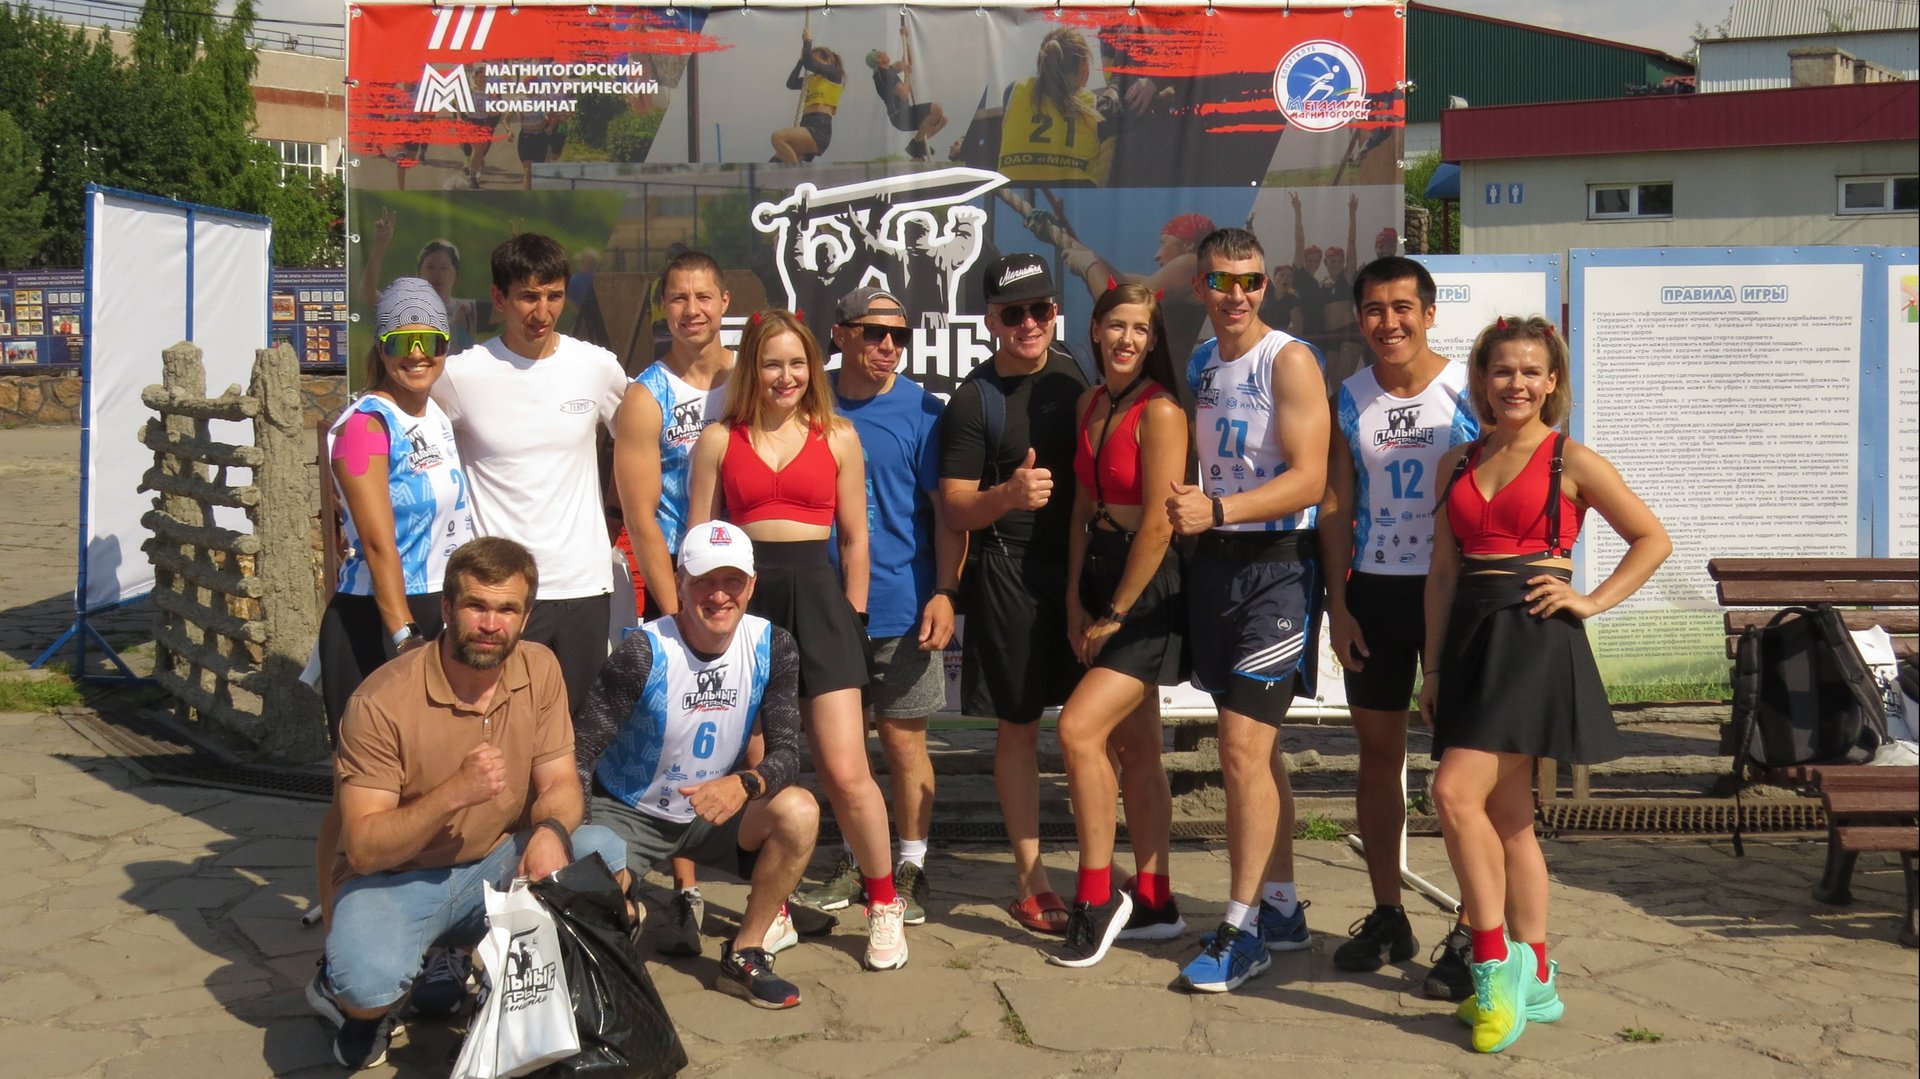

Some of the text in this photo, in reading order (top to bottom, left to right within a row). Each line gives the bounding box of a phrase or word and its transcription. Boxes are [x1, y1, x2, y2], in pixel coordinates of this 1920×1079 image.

[485, 62, 643, 77] МАГНИТОГОРСКИЙ
[485, 79, 659, 95] МЕТАЛЛУРГИЧЕСКИЙ
[485, 99, 578, 113] КОМБИНАТ
[1290, 110, 1368, 119] МАГНИТОГОРСК
[1028, 113, 1077, 147] 21
[1664, 288, 1787, 301] ПРАВИЛА ИГРЫ
[1215, 416, 1248, 460] 27
[1374, 428, 1434, 446] СТАЛЬНЫЕ
[1384, 460, 1424, 499] 12
[683, 690, 736, 709] СТАЛЬНЫЕ
[692, 722, 717, 759] 6
[504, 985, 537, 1002] ГРЫ
